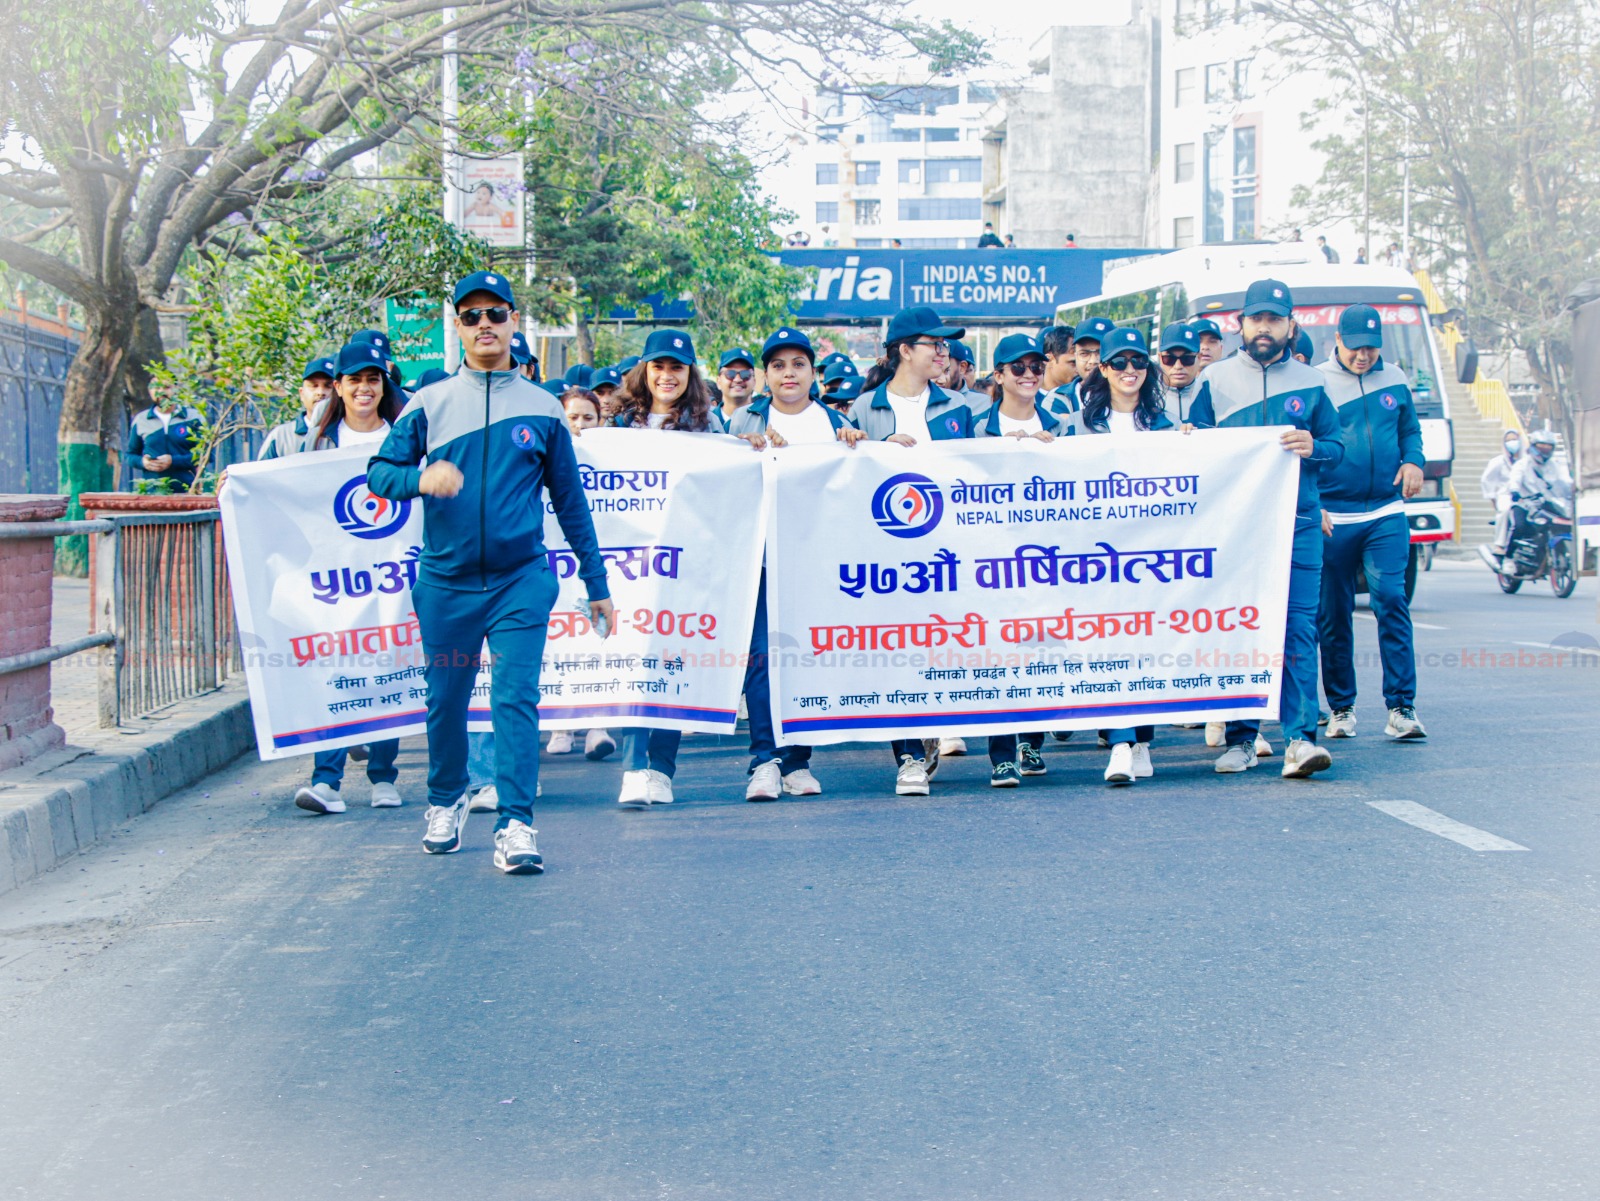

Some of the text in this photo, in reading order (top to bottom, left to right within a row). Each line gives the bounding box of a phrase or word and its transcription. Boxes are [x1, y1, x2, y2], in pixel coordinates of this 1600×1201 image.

[923, 265, 1046, 284] INDIA'S NO.1
[911, 285, 1058, 304] TILE COMPANY
[577, 463, 670, 492] धिकरण
[950, 471, 1200, 505] नेपाल बीमा प्राधिकरण
[589, 497, 667, 512] UTHORITY
[956, 501, 1198, 526] NEPAL INSURANCE AUTHORITY
[974, 542, 1217, 590] वार्षिकोत्सव
[289, 611, 423, 668] प्रभातफे
[809, 612, 989, 657] प्रभातफेरी
[374, 664, 427, 686] कम्पनीब
[605, 657, 635, 673] नपाए
[642, 657, 659, 670] वा
[664, 655, 685, 676] कुनै
[1012, 666, 1021, 679] र
[1024, 660, 1059, 676] बीमित
[1063, 659, 1084, 676] हित
[570, 677, 622, 695] जानकारी
[886, 689, 930, 706] परिवार
[934, 691, 944, 704] र
[948, 685, 1001, 702] सम्पतीको
[1006, 684, 1033, 699] बीमा
[1036, 681, 1066, 698] गराई
[1070, 679, 1123, 695] भविष्यको
[1127, 676, 1167, 693] आर्थिक
[1172, 673, 1213, 690] पक्षप्रति
[1217, 674, 1246, 690] ढुक्क
[327, 686, 428, 715] समस्या भए नेप
